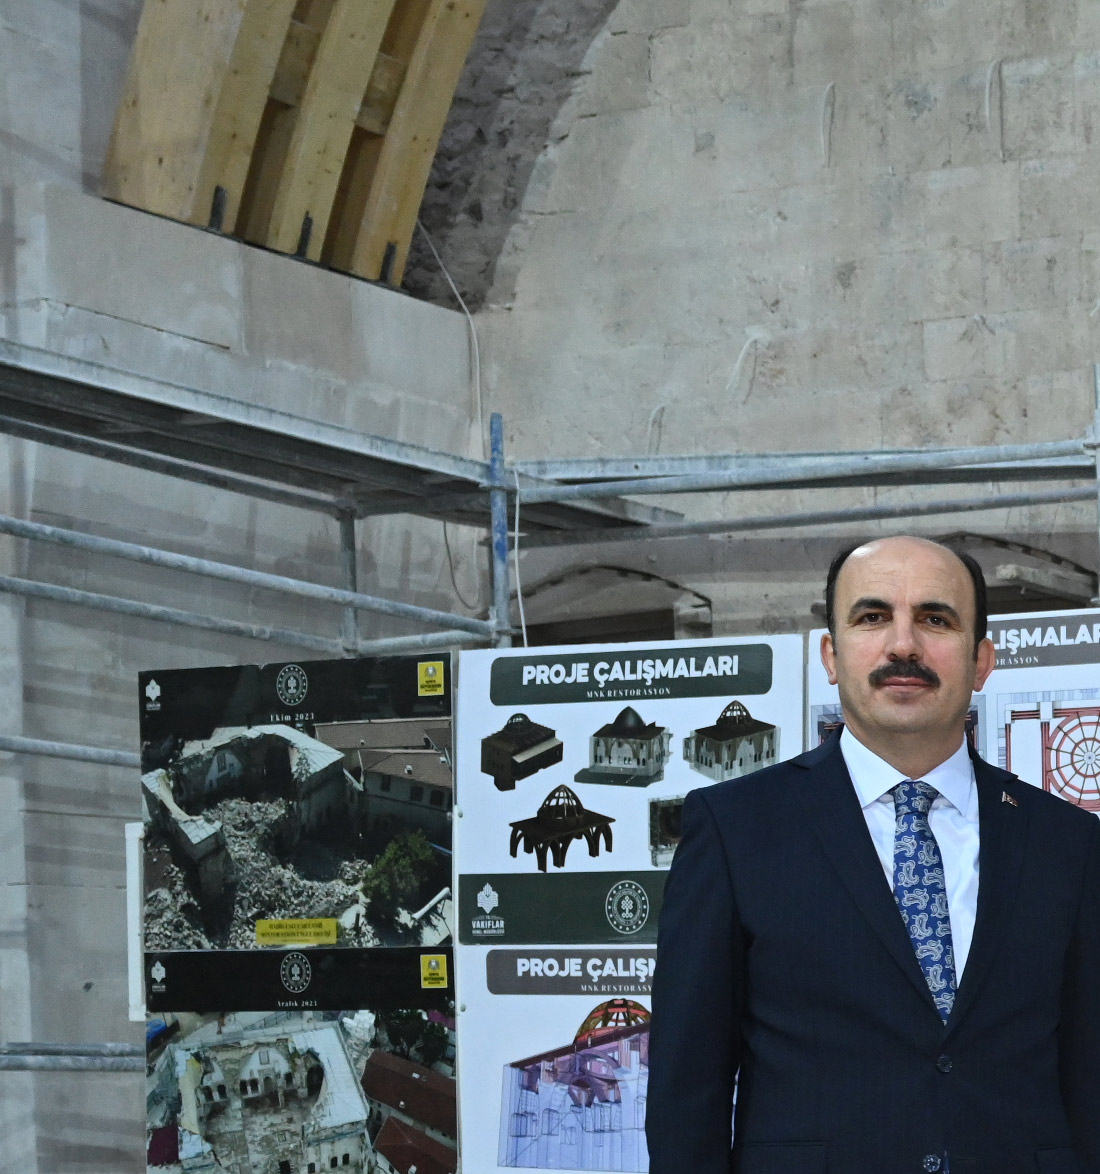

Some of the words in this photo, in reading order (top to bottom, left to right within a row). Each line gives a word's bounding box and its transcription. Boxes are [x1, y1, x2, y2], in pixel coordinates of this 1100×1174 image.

[995, 656, 1039, 666] RASYON
[522, 662, 589, 686] PROJE
[593, 655, 739, 688] ÇALIŞMALARI
[586, 690, 605, 699] MNK
[607, 687, 671, 698] RESTORASYON
[472, 920, 505, 929] VAKIFLAR
[516, 958, 582, 977] PROJE
[580, 984, 600, 992] MNK
[601, 984, 652, 992] RESTORASY
